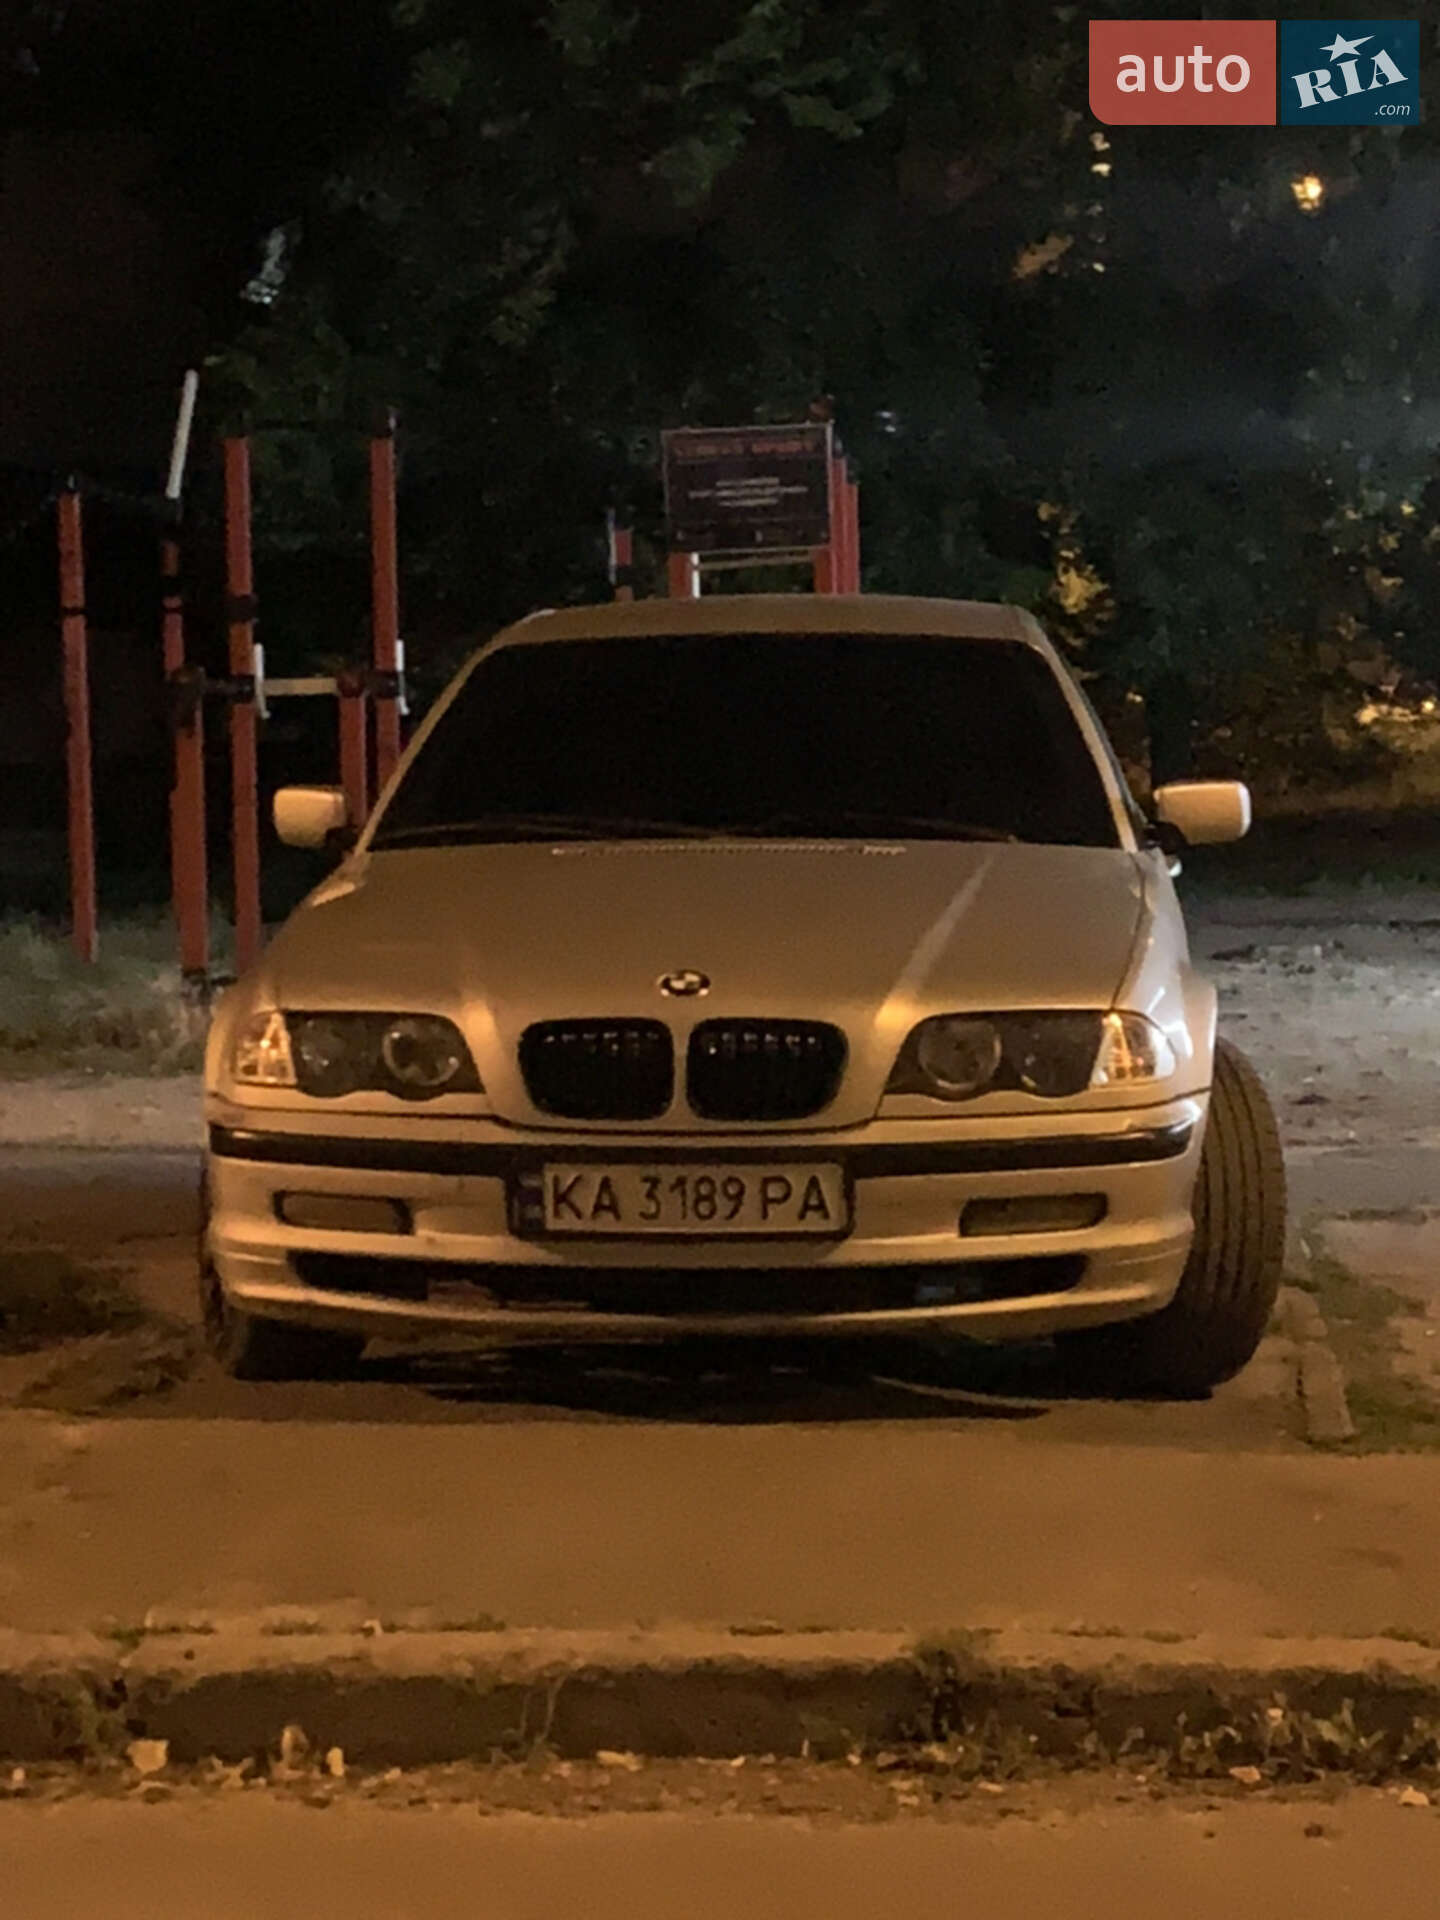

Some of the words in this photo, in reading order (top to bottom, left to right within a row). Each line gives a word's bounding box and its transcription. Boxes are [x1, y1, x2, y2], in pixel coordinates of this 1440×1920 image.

[552, 1173, 622, 1221] KA
[639, 1174, 747, 1221] 3189
[759, 1174, 830, 1221] PA
